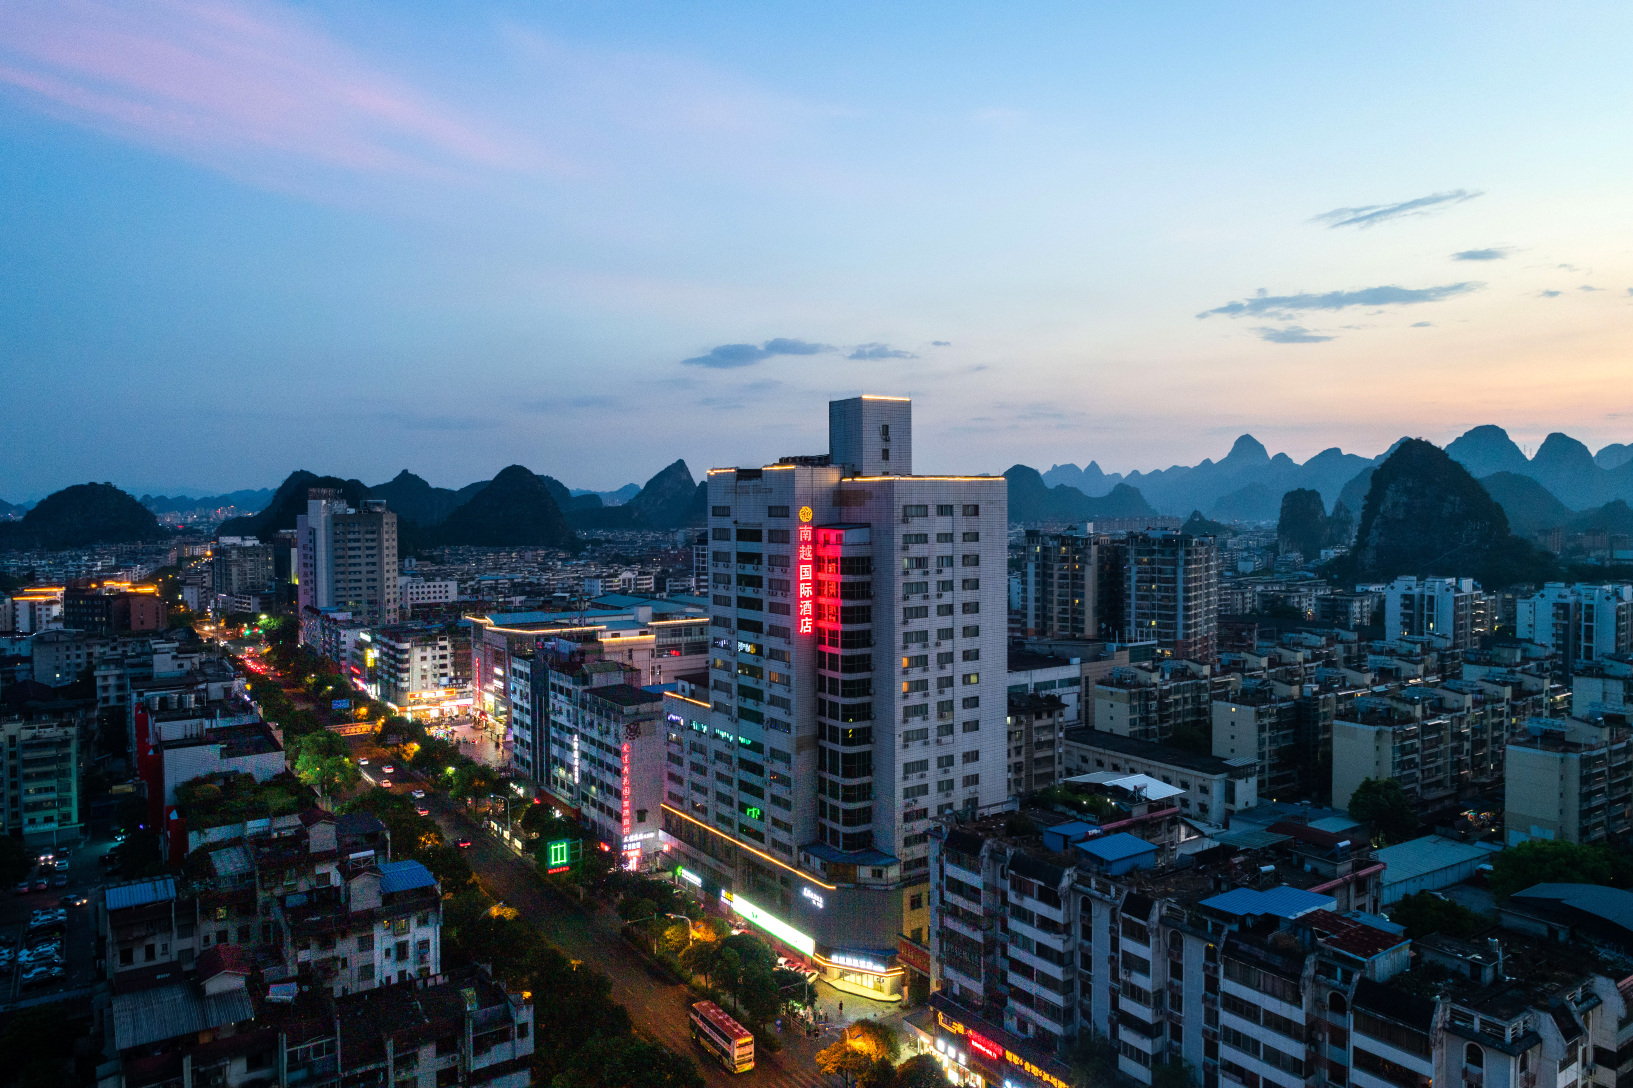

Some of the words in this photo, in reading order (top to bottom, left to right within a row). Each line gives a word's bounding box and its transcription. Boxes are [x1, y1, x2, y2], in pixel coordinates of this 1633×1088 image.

[799, 525, 813, 633] 南越国际酒店
